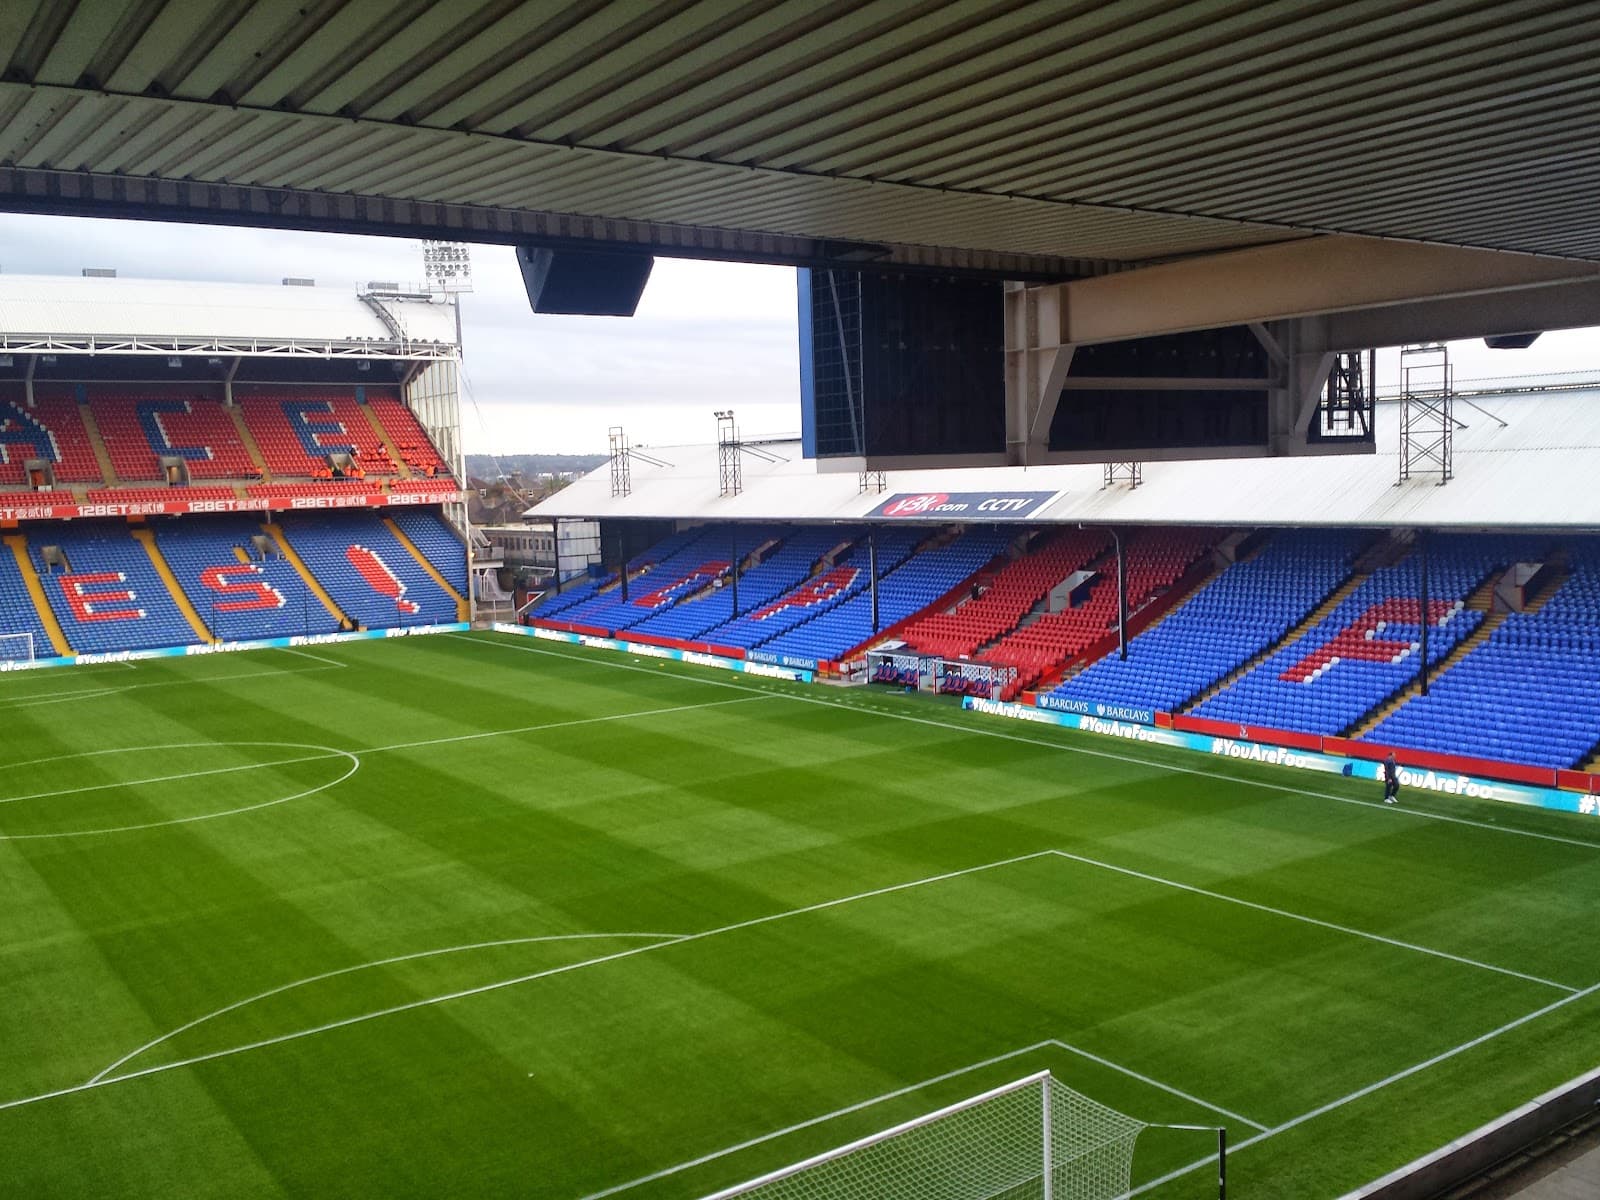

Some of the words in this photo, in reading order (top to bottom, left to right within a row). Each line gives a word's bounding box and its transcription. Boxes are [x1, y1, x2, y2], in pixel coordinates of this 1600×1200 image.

[291, 497, 335, 508] 12BET
[387, 494, 428, 505] 12BET
[977, 498, 1033, 511] CCTV
[78, 504, 128, 516] 12BET
[188, 500, 235, 512] 12BET
[1049, 697, 1088, 712] BARCLAYS
[1107, 706, 1149, 721] BARCLAYS
[1212, 738, 1306, 768] #YouAreFoo
